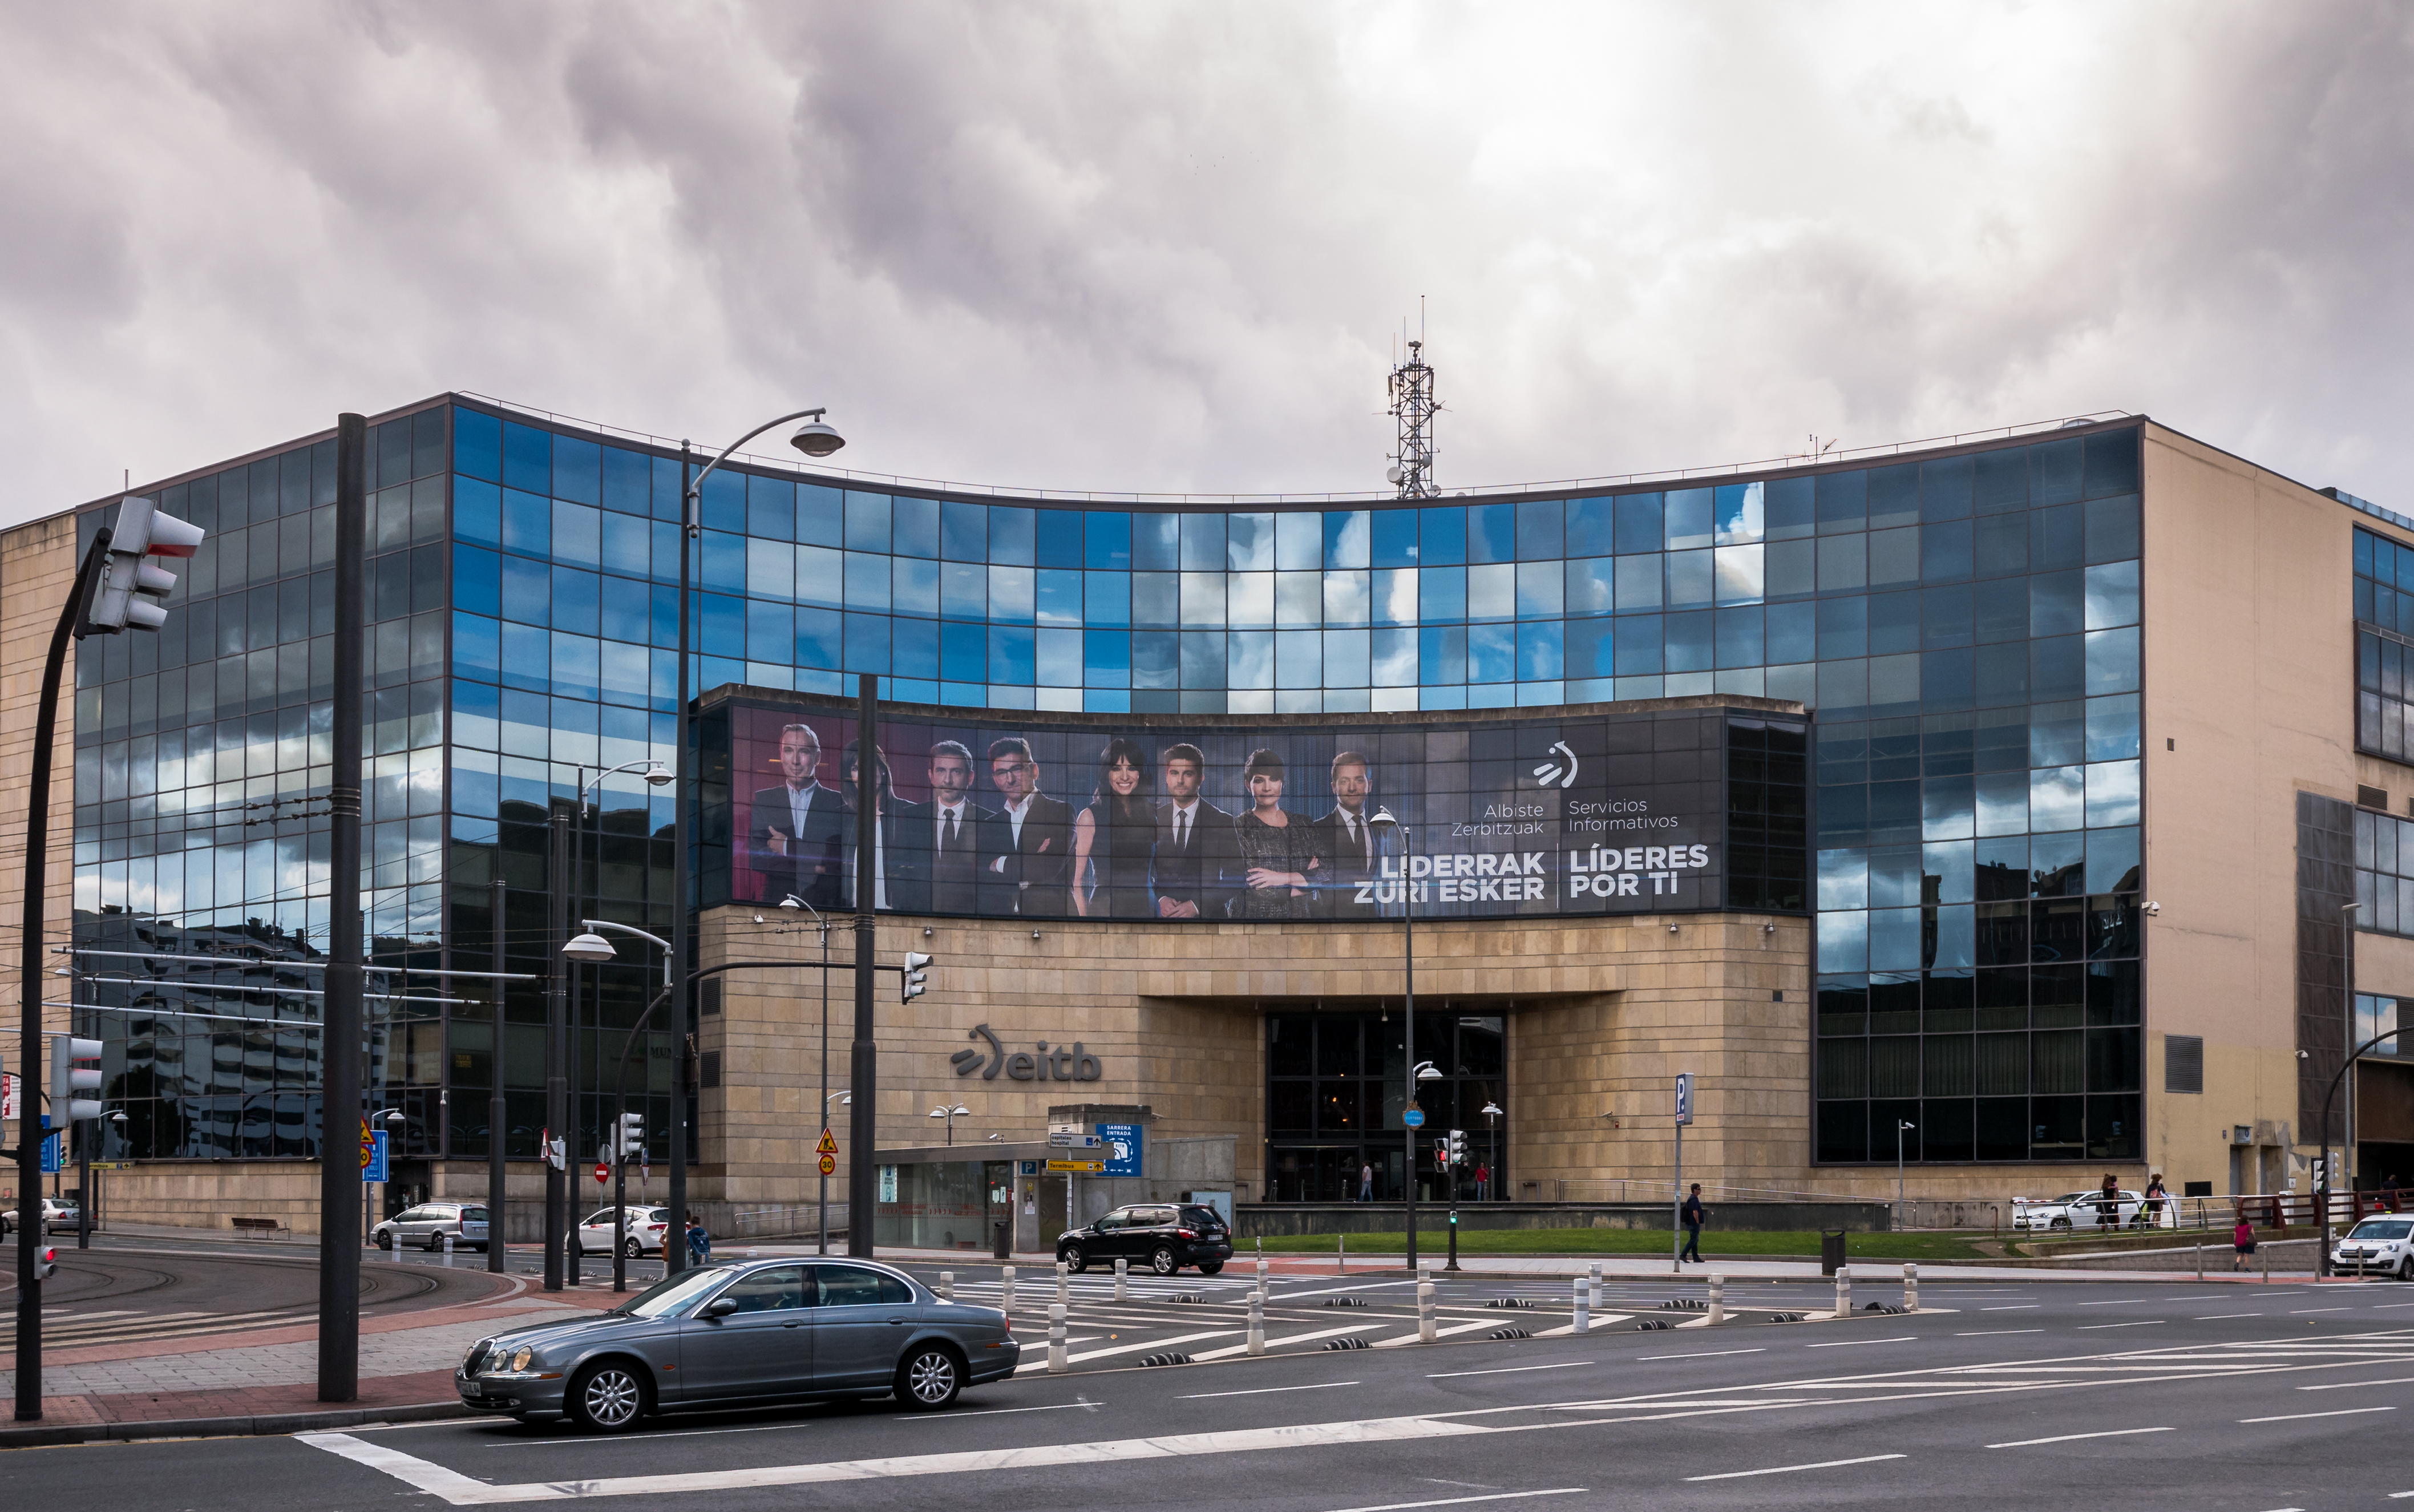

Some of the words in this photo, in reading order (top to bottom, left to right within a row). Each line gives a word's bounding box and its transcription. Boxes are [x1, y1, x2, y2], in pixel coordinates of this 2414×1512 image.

[1483, 803, 1544, 818] Albiste
[1569, 799, 1647, 815] Servicios
[1451, 820, 1544, 836] Zerbitzuak
[1569, 815, 1678, 832] Informativos
[1381, 852, 1546, 879] LIDERRAK
[1570, 843, 1709, 872] LÍDERES
[1354, 880, 1428, 904] ZURI
[1439, 877, 1545, 902] ESKER
[1570, 874, 1639, 898] POR
[1648, 871, 1677, 895] TI
[1006, 1040, 1102, 1082] eitb
[1677, 1078, 1685, 1113] P
[1025, 1163, 1032, 1173] P
